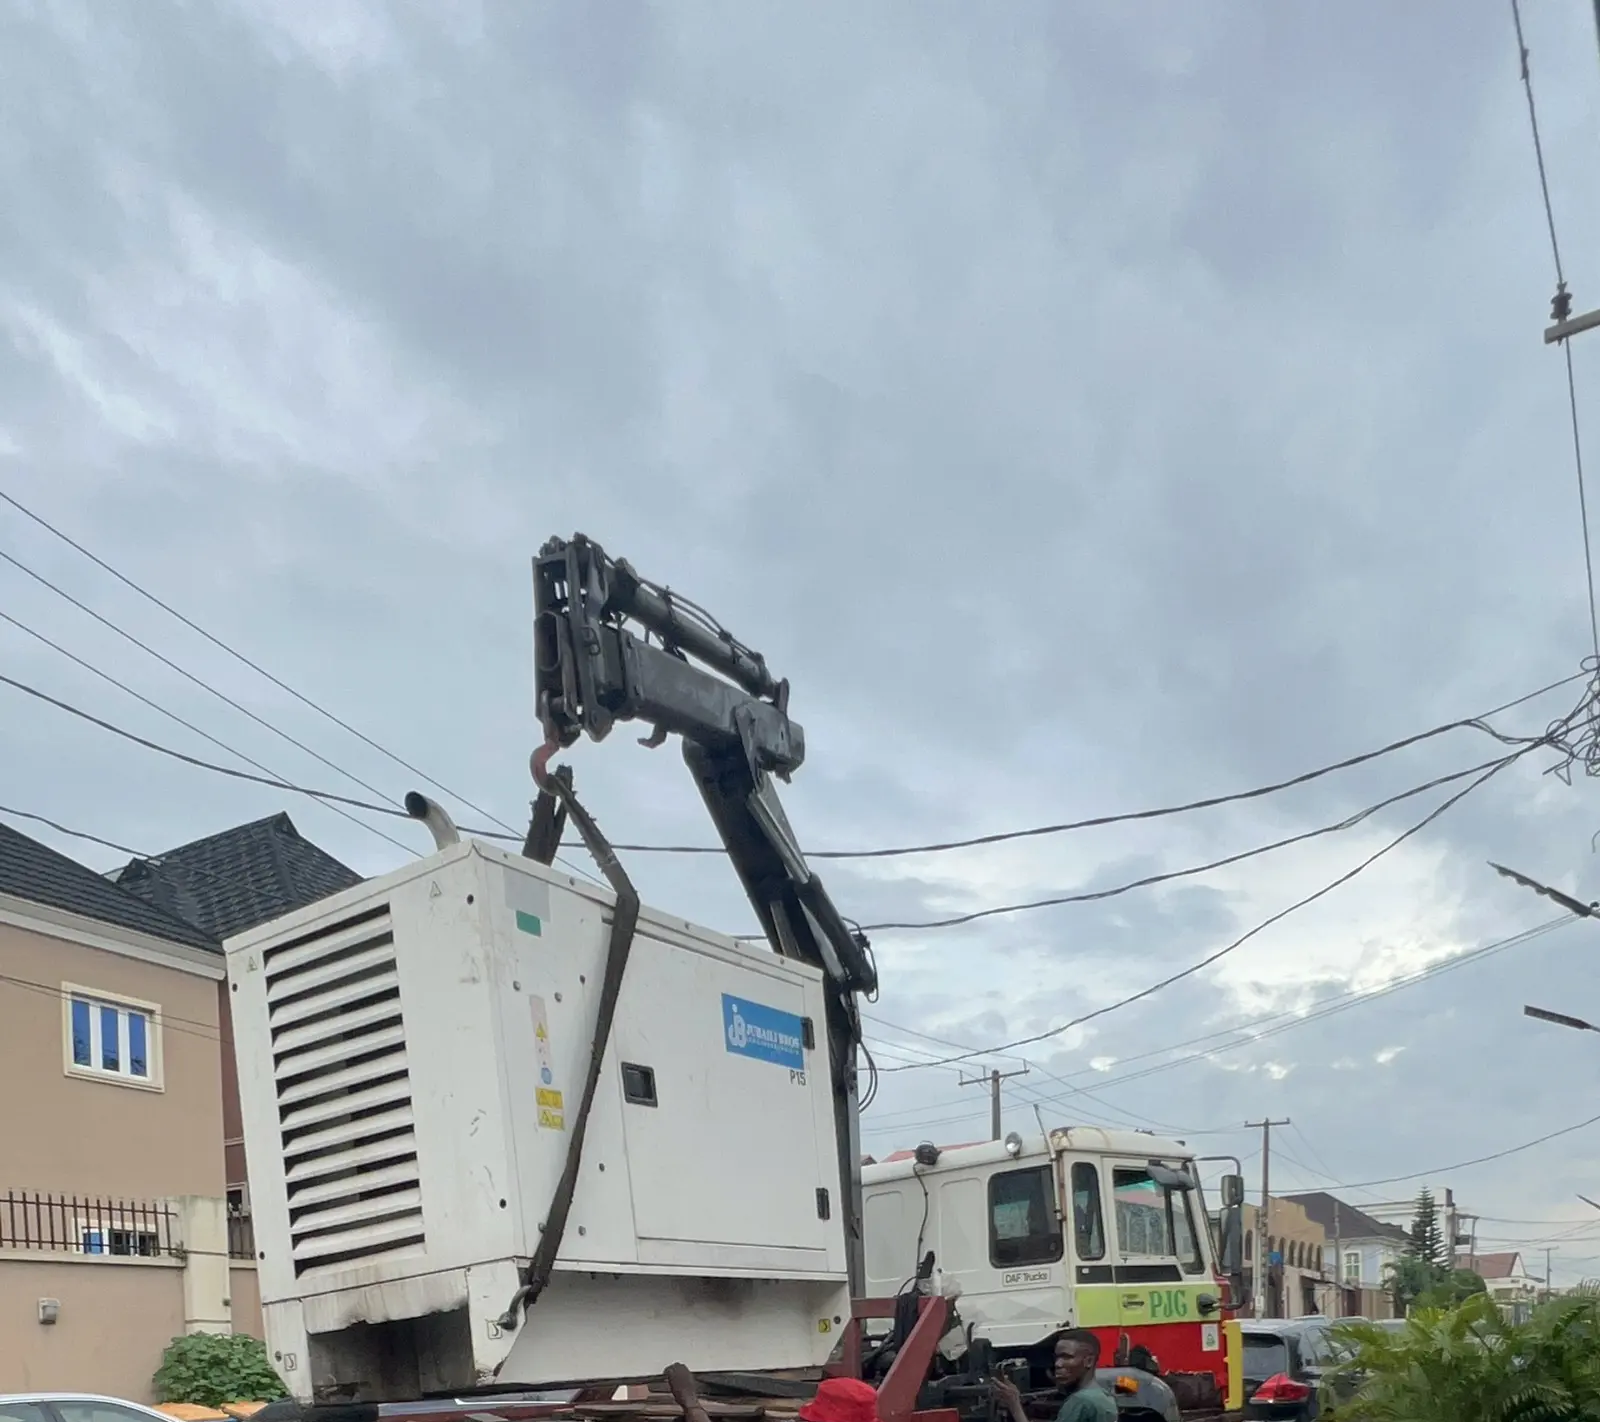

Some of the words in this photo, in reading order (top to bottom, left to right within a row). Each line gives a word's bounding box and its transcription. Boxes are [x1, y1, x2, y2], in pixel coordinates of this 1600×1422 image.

[746, 1023, 778, 1043] JUBAILI
[778, 1032, 800, 1049] BROS
[789, 1069, 806, 1086] P15
[1005, 1273, 1022, 1284] DAF
[1022, 1271, 1048, 1281] Trucks
[1149, 1289, 1188, 1319] PJG
